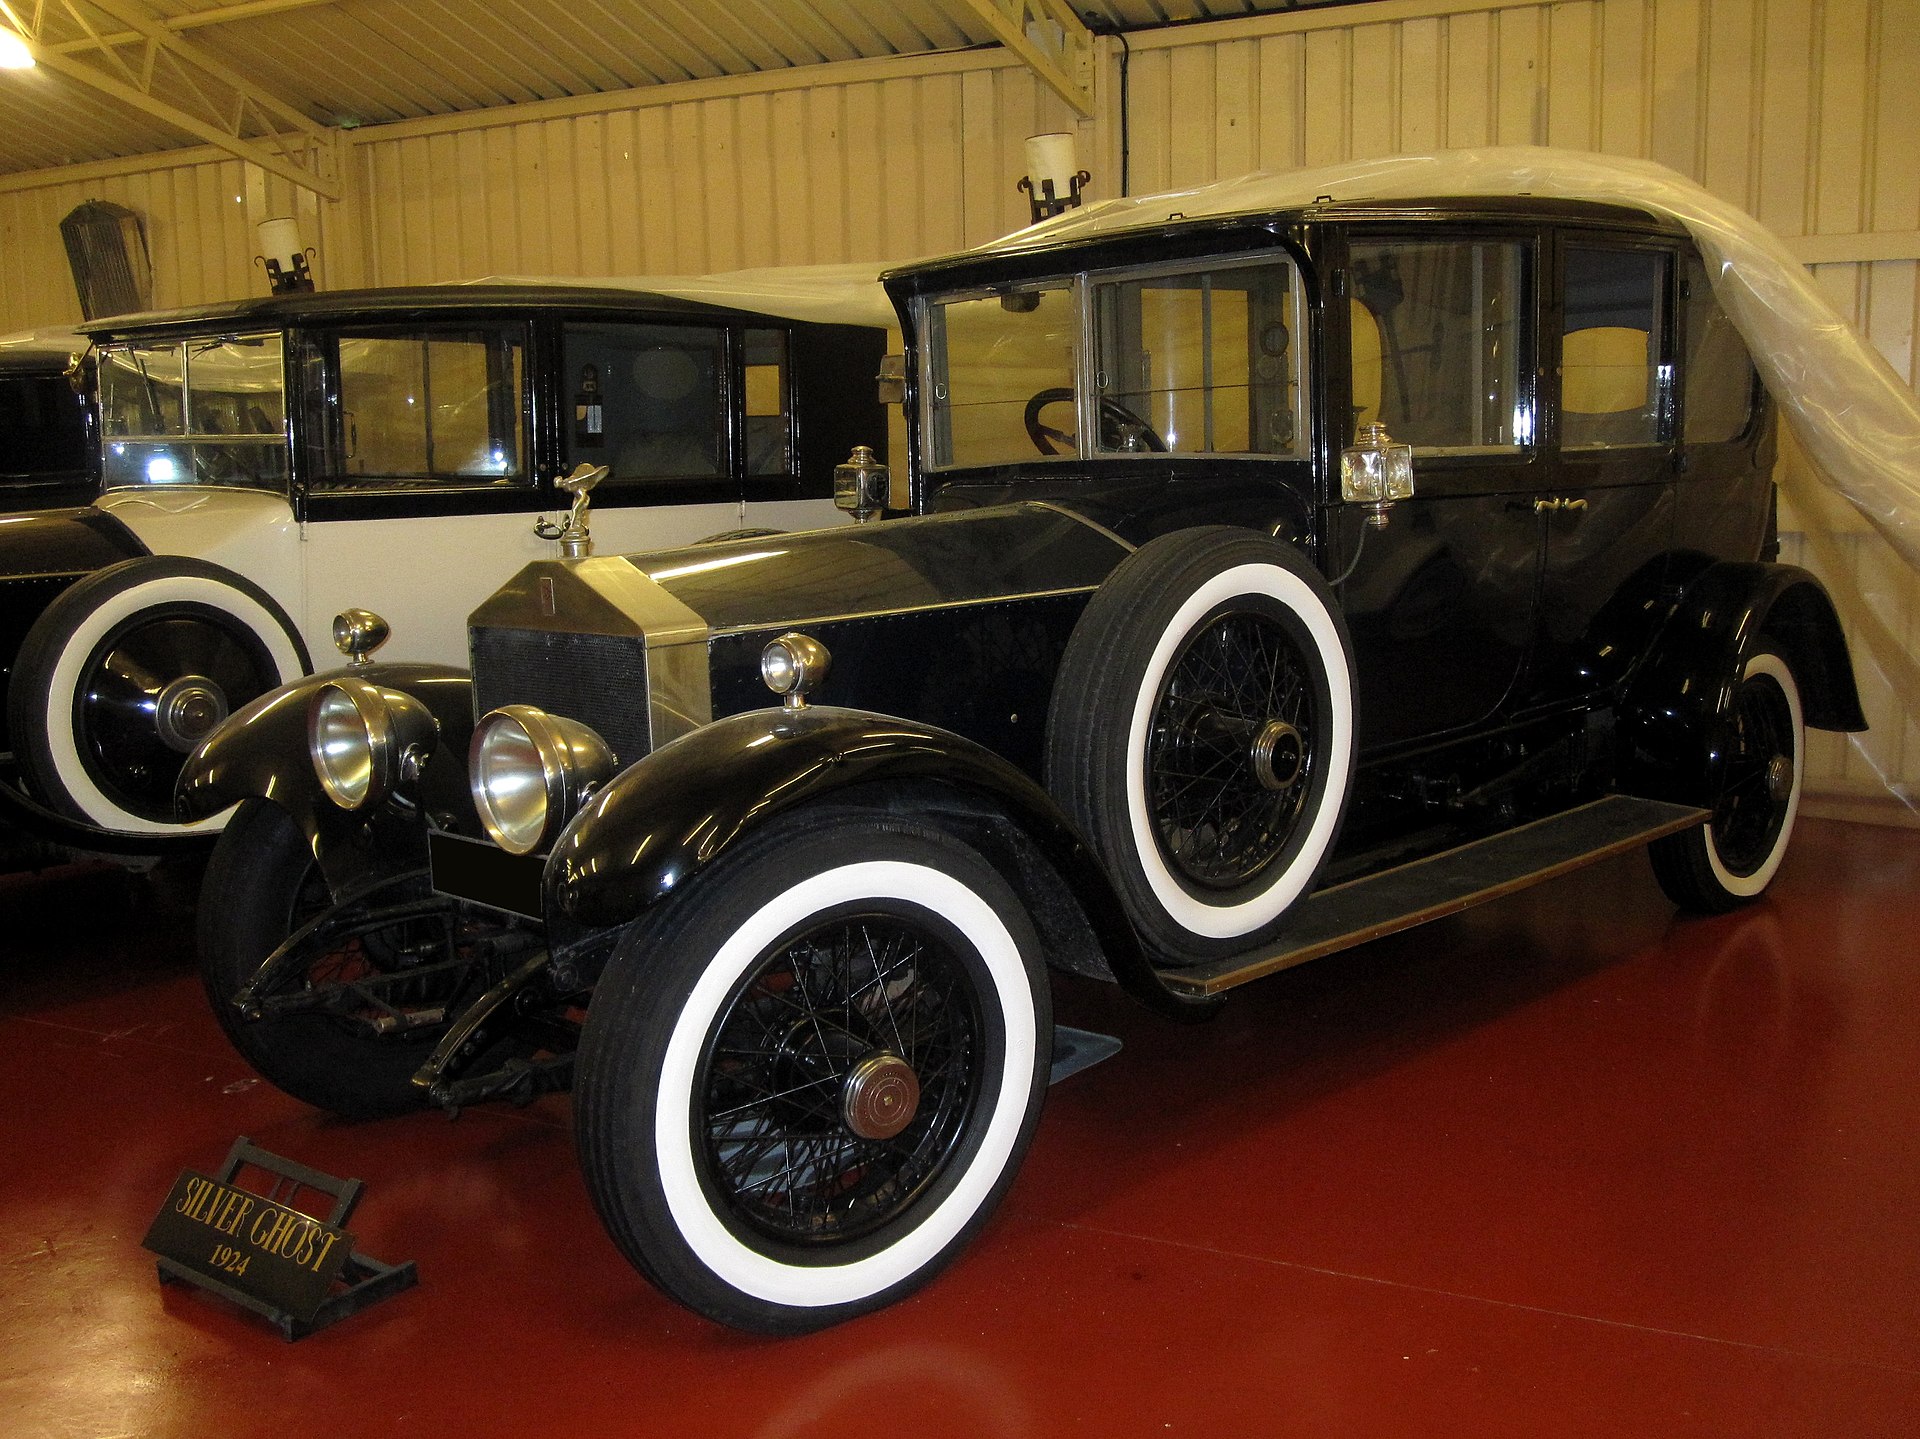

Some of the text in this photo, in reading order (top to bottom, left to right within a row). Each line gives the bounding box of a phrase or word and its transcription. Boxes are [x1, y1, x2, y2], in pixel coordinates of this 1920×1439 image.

[176, 1177, 340, 1272] SILVER GHOST
[209, 1245, 251, 1276] 1924
